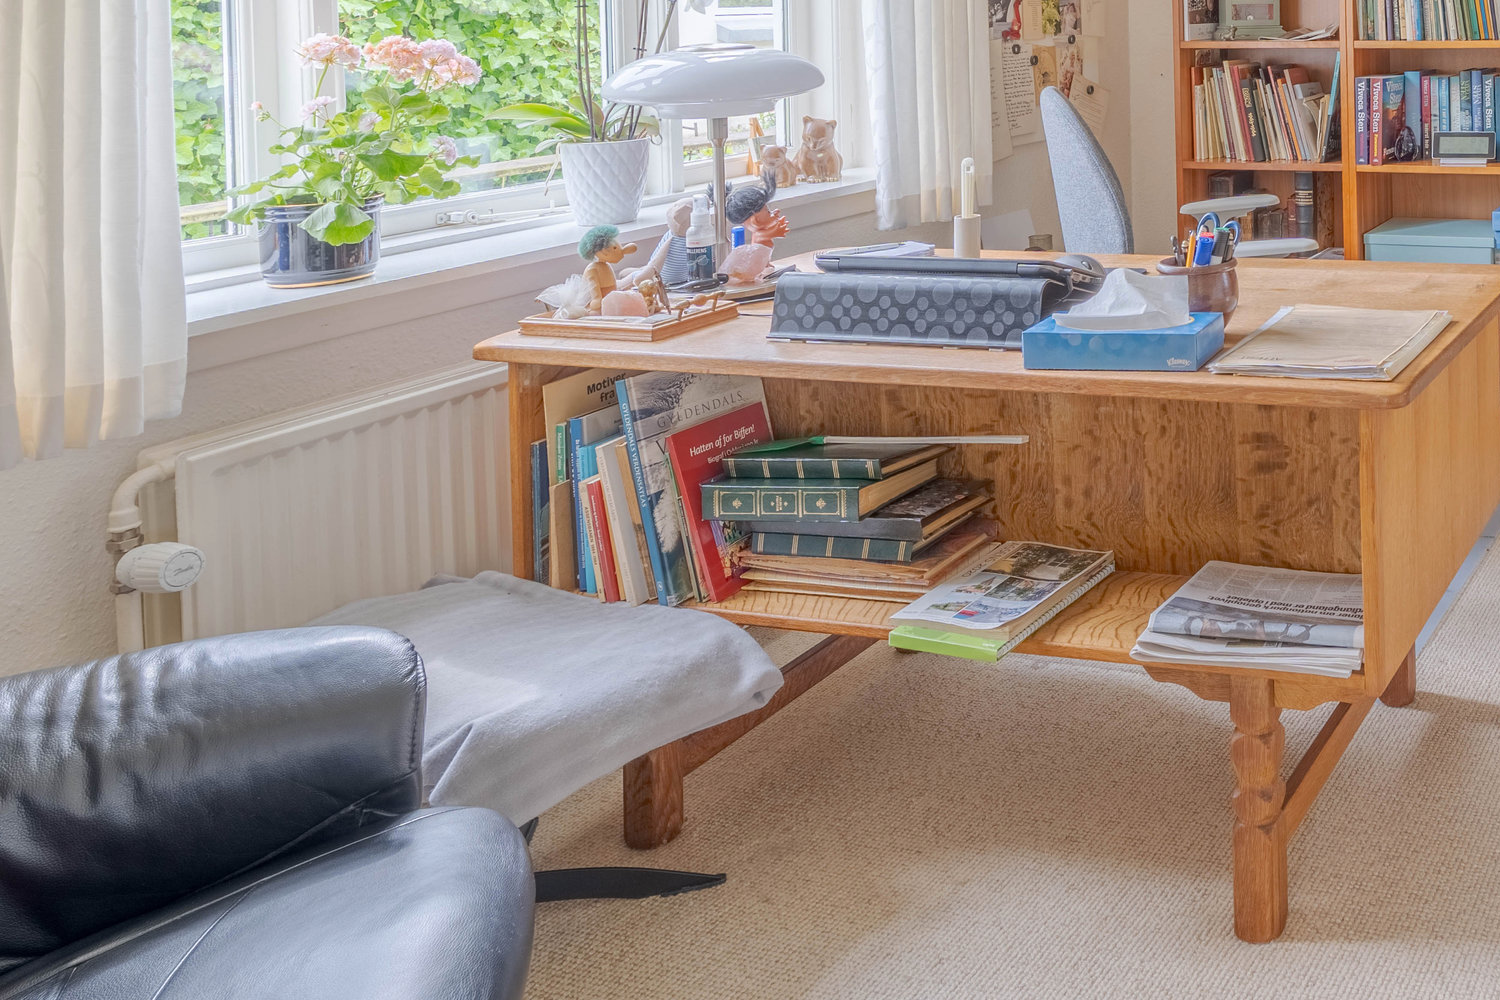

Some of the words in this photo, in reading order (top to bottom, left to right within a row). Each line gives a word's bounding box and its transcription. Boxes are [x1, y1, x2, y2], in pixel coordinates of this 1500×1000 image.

[1357, 82, 1365, 110] Viveca
[1372, 82, 1381, 110] Viveca
[1485, 79, 1493, 108] Viveca
[1358, 112, 1366, 133] Sten
[1373, 112, 1381, 133] Sten
[1485, 109, 1493, 129] Sten
[587, 373, 626, 395] Motiver
[600, 390, 615, 402] fra
[657, 390, 744, 429] GYLDENDALS
[621, 402, 637, 452] GYLDENDALS
[631, 453, 648, 508] VERDENSATLAS
[689, 442, 714, 457] Hatten
[715, 437, 724, 449] af
[722, 433, 733, 447] for
[733, 425, 755, 439] Biffen!
